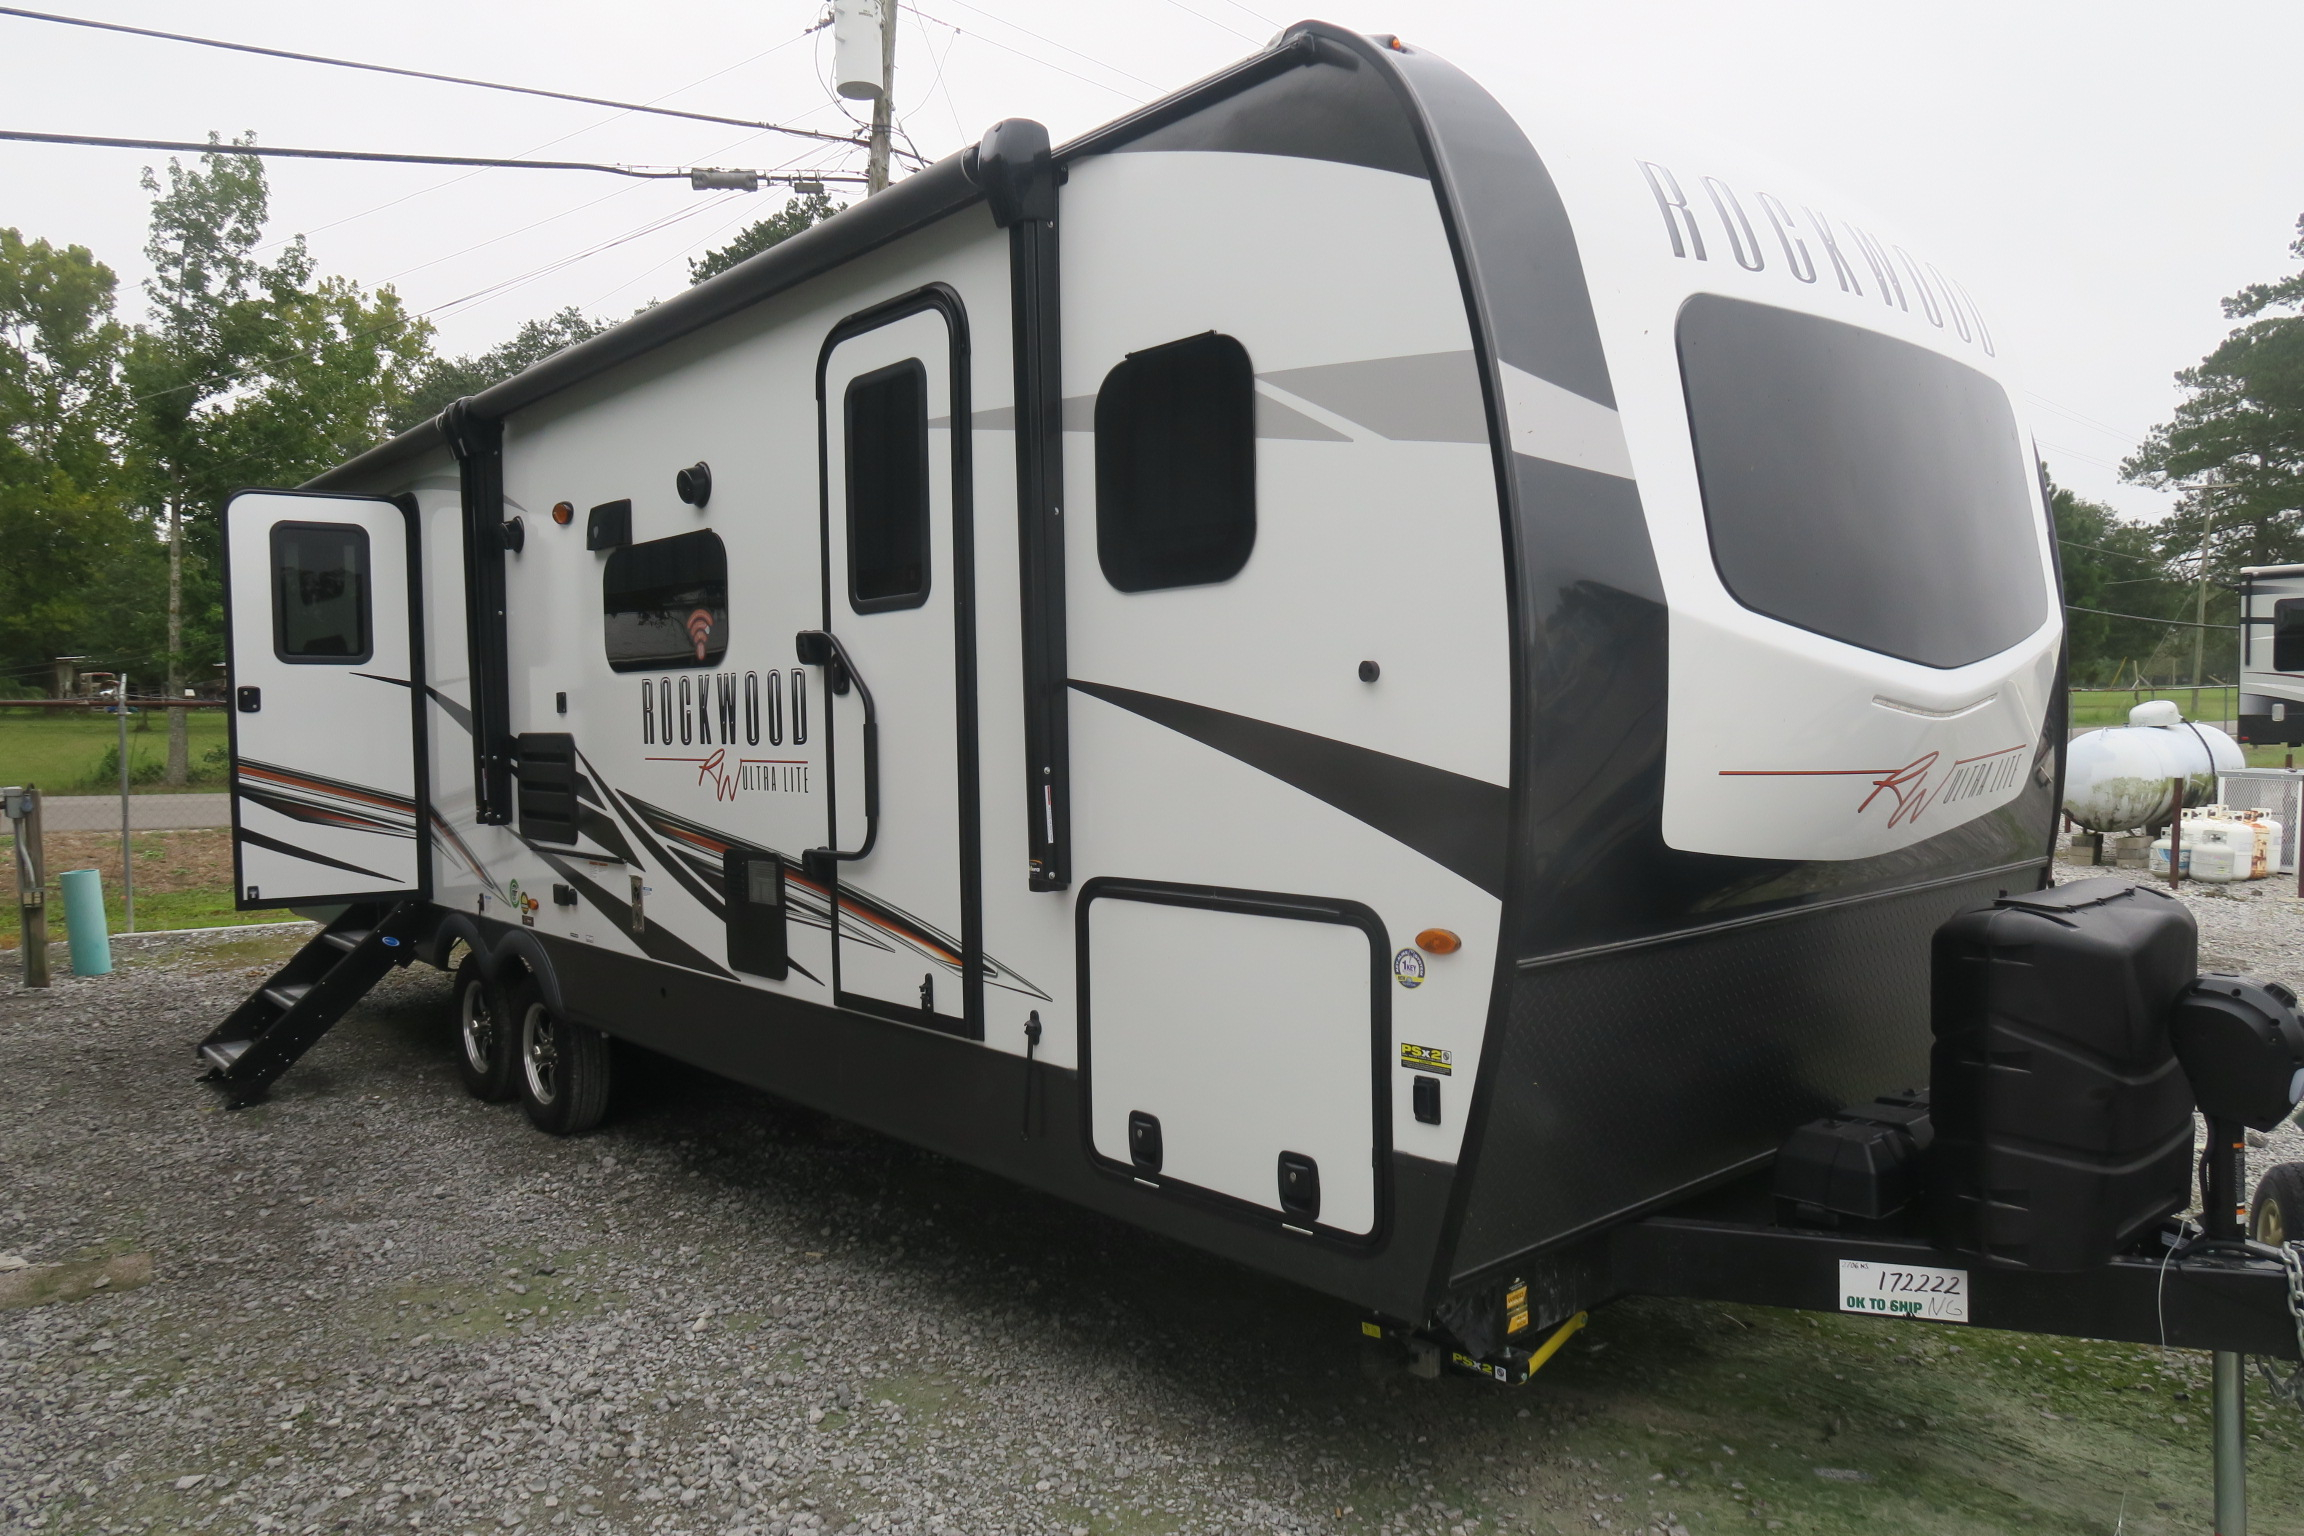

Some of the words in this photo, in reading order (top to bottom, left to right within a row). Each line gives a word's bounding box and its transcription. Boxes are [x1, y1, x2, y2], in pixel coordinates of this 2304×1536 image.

[1634, 157, 1996, 358] ROCKWOOD
[642, 667, 808, 746] ROCKWOOD
[698, 748, 743, 802] RW
[742, 765, 777, 792] ULTRA
[783, 766, 809, 794] LITE
[1943, 761, 1993, 804] ULTRA
[1989, 753, 2023, 793] LITE
[1846, 1295, 1866, 1309] OK
[1869, 1297, 1886, 1311] TO
[1890, 1299, 1923, 1314] SHIP
[1879, 1271, 1961, 1295] 172222
